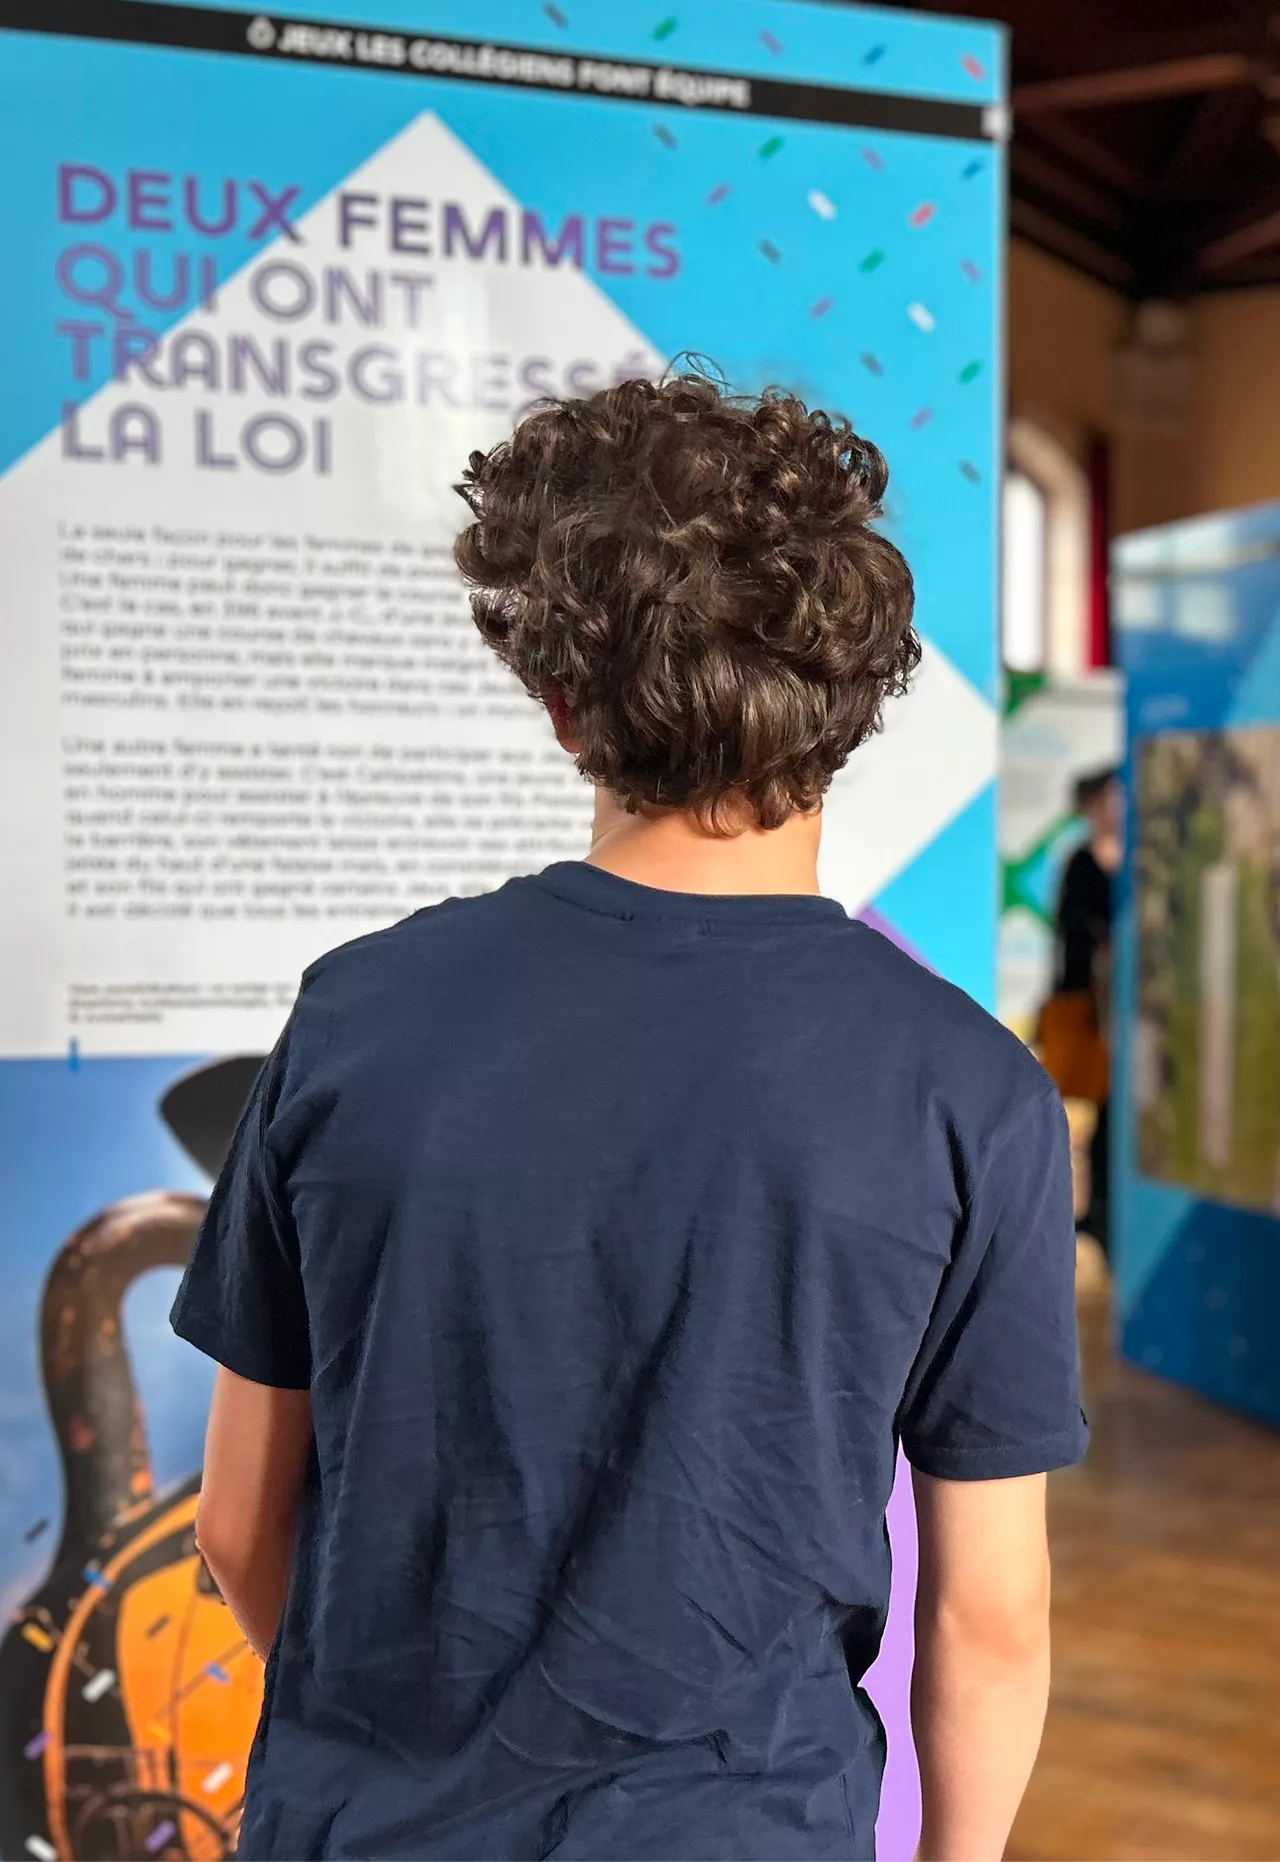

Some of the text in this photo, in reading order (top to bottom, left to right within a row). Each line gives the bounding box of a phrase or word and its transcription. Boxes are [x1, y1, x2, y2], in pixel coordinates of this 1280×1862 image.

[278, 24, 351, 59] JEUX
[355, 33, 405, 65] LES
[409, 39, 575, 88] COLLÉGIENS
[577, 60, 650, 96] FONT
[653, 68, 751, 108] ÉQUIPE
[57, 163, 681, 278] DEUX FEMMES
[56, 242, 434, 330] QUI ONT
[61, 398, 332, 475] LA LOI
